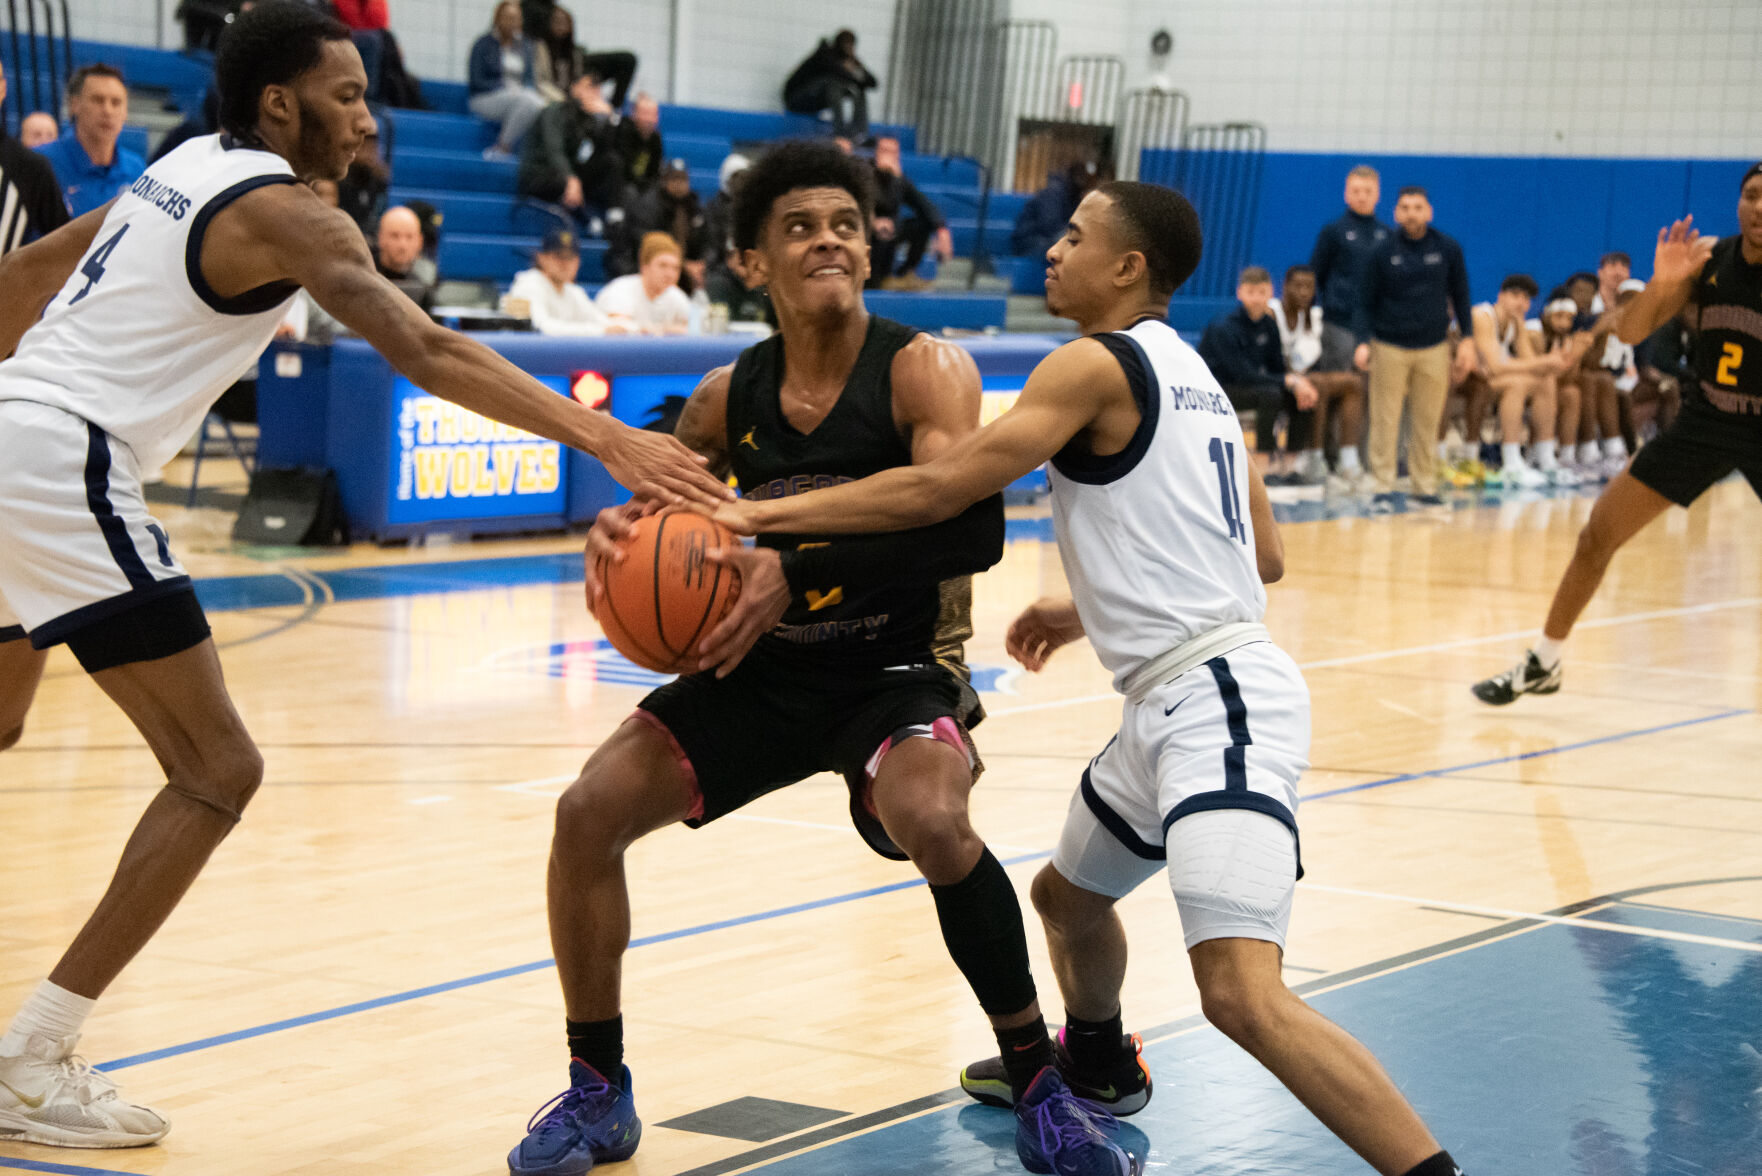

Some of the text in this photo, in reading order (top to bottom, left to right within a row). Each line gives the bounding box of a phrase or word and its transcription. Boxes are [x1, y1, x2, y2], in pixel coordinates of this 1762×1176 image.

[68, 222, 130, 306] 4
[1716, 341, 1743, 386] 2
[414, 444, 559, 499] WOLVES
[1208, 437, 1246, 545] 11
